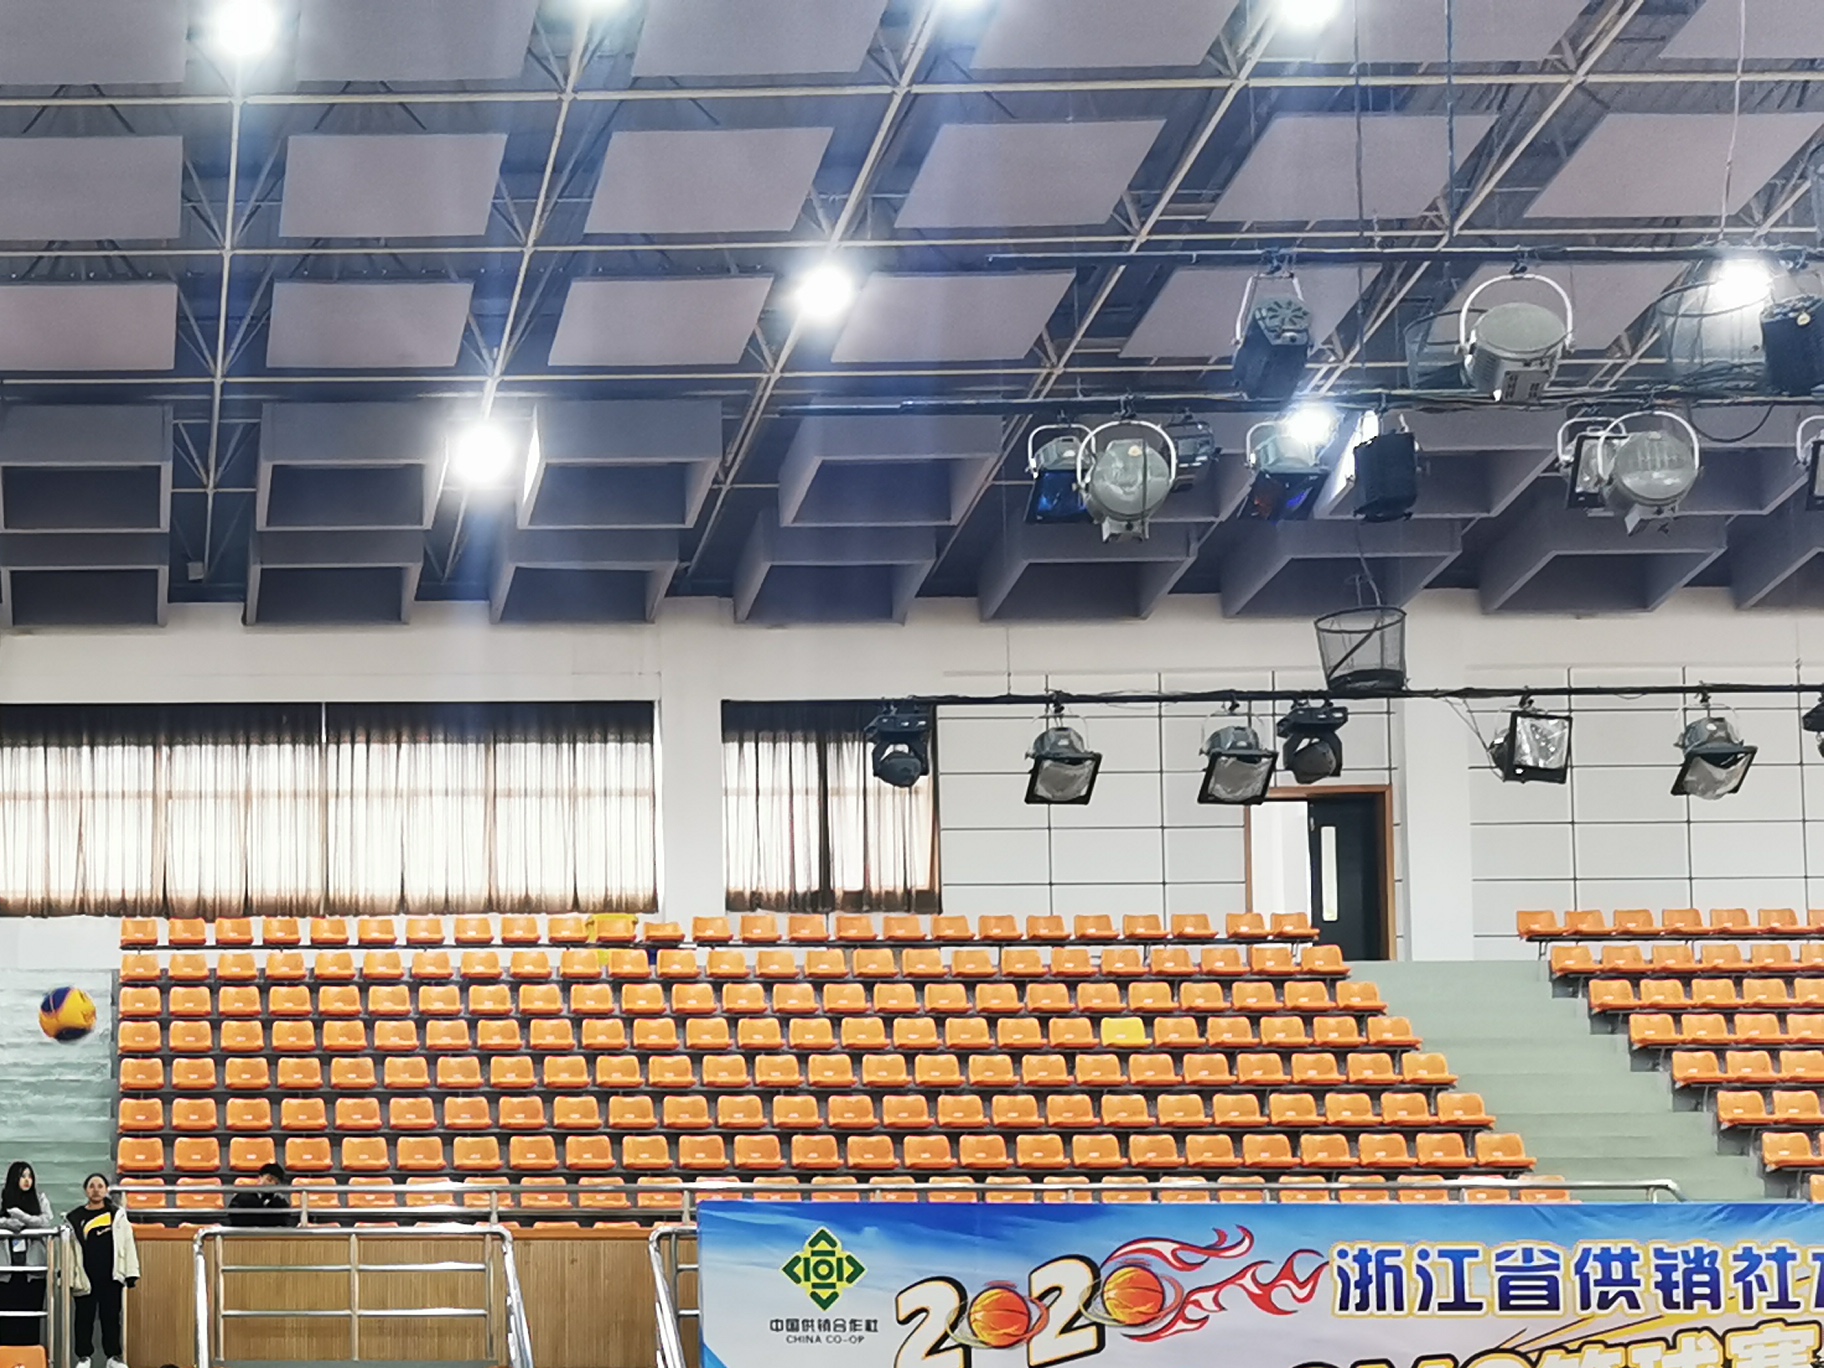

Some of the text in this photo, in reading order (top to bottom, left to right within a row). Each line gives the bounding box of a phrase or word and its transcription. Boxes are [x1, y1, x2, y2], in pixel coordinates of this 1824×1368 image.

[1331, 1243, 1824, 1316] 浙江省供销社
[770, 1318, 879, 1334] 中国供销合作社
[785, 1335, 866, 1345] CHINA CO-OP
